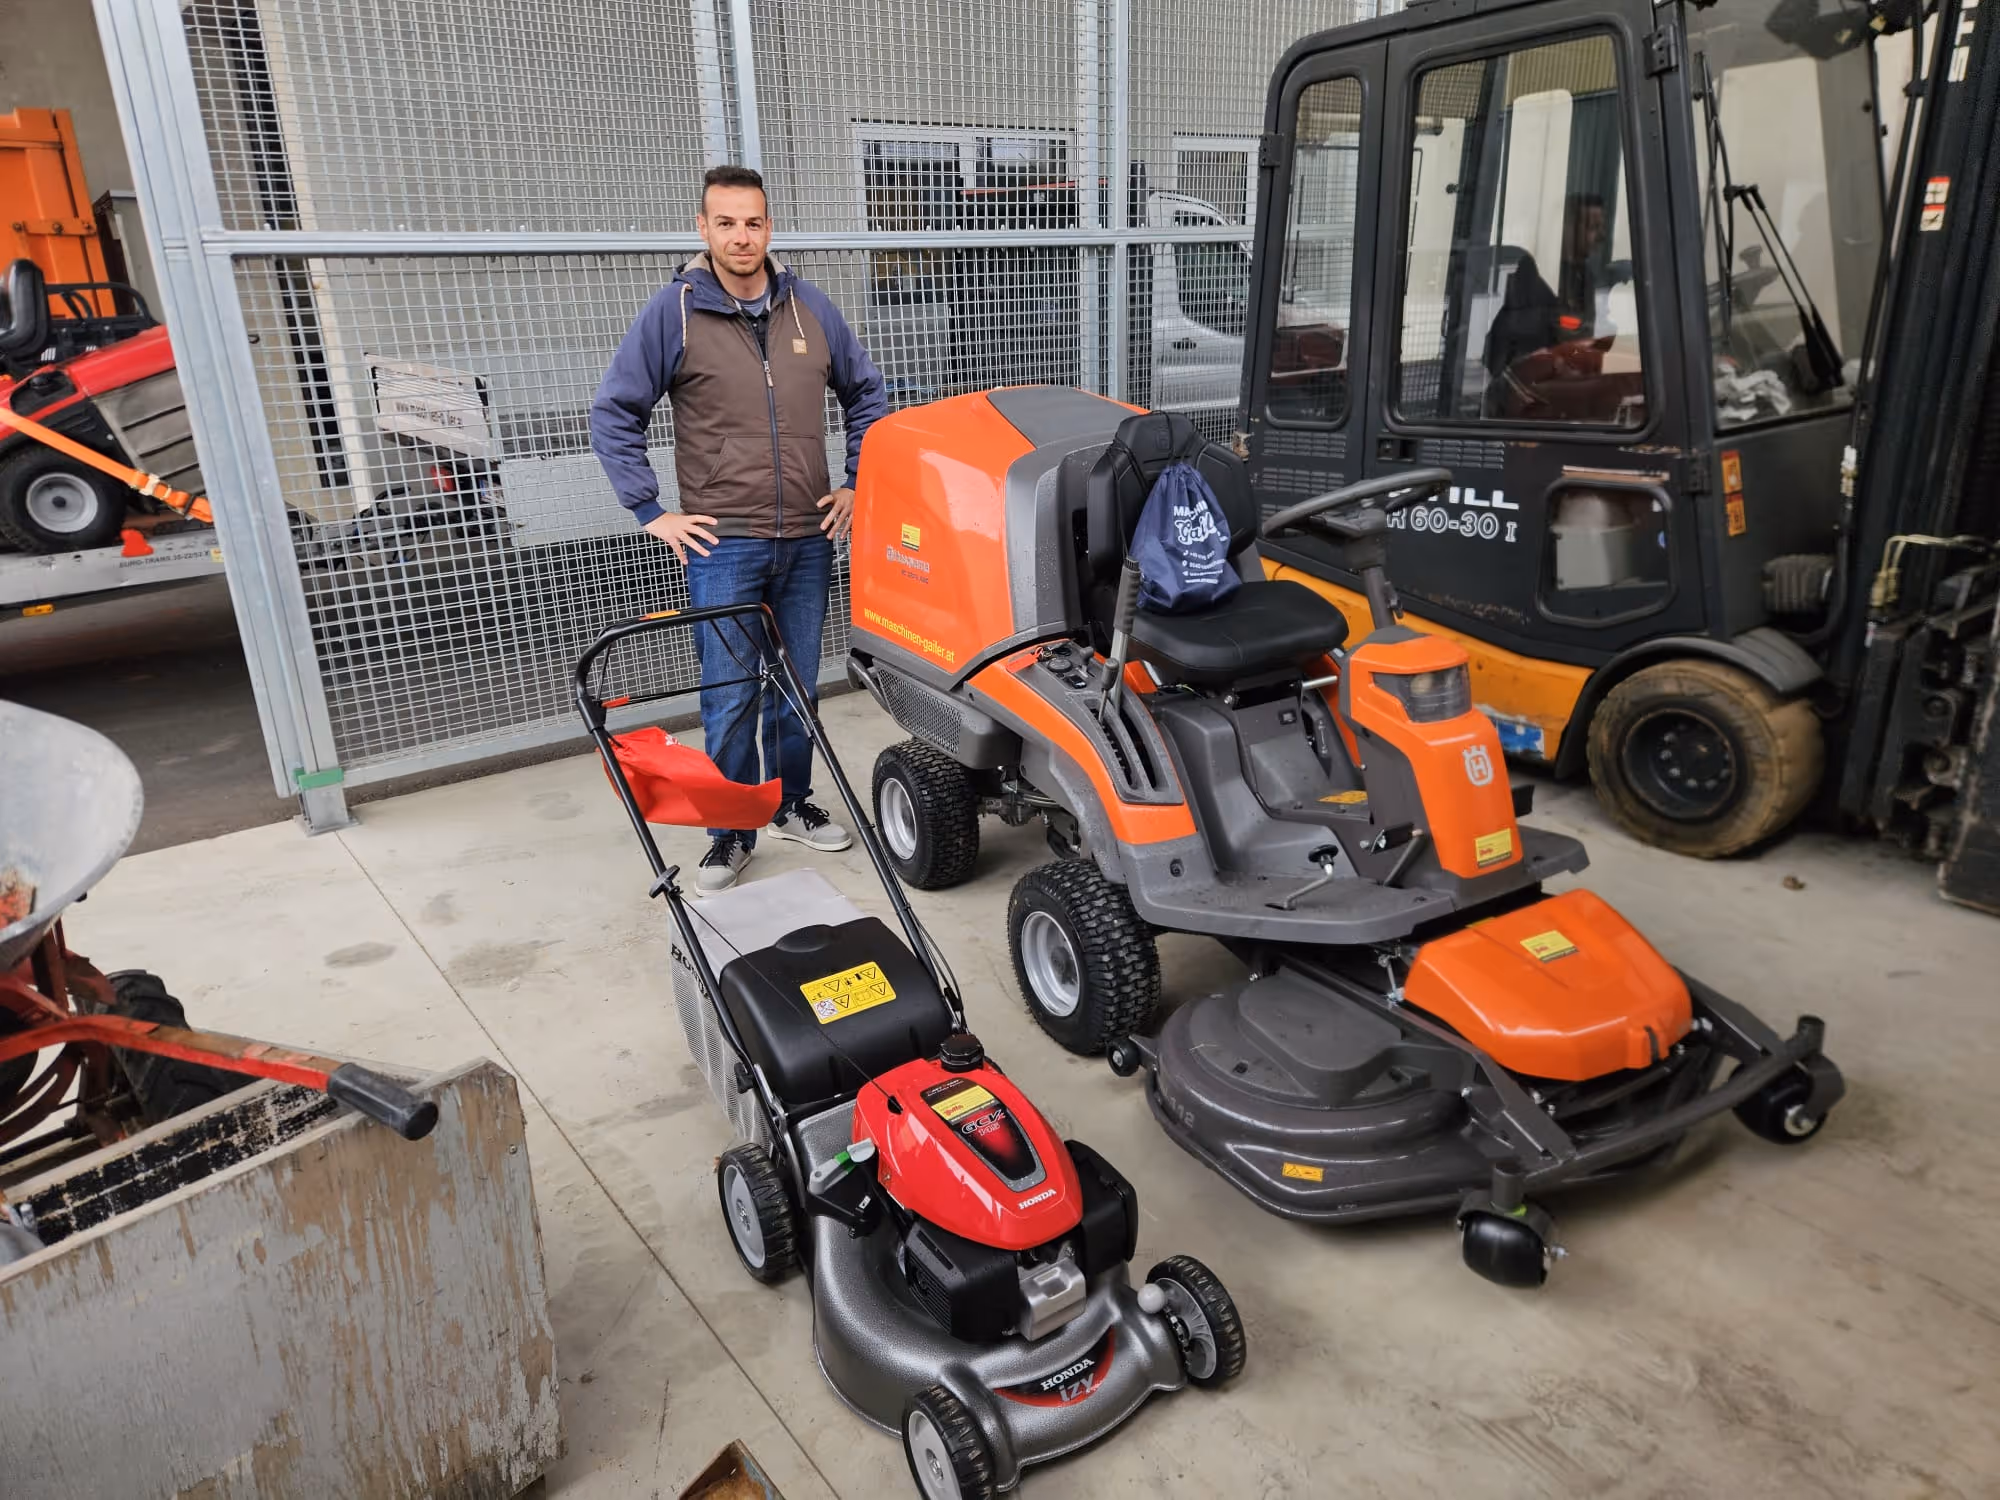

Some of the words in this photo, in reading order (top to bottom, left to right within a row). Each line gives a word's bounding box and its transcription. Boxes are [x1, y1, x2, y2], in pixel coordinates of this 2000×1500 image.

[1410, 505, 1499, 540] 60-30
[864, 607, 955, 664] www.maschinen-gailer.at
[1018, 1188, 1057, 1210] HONDA
[1040, 1358, 1095, 1391] HONDA
